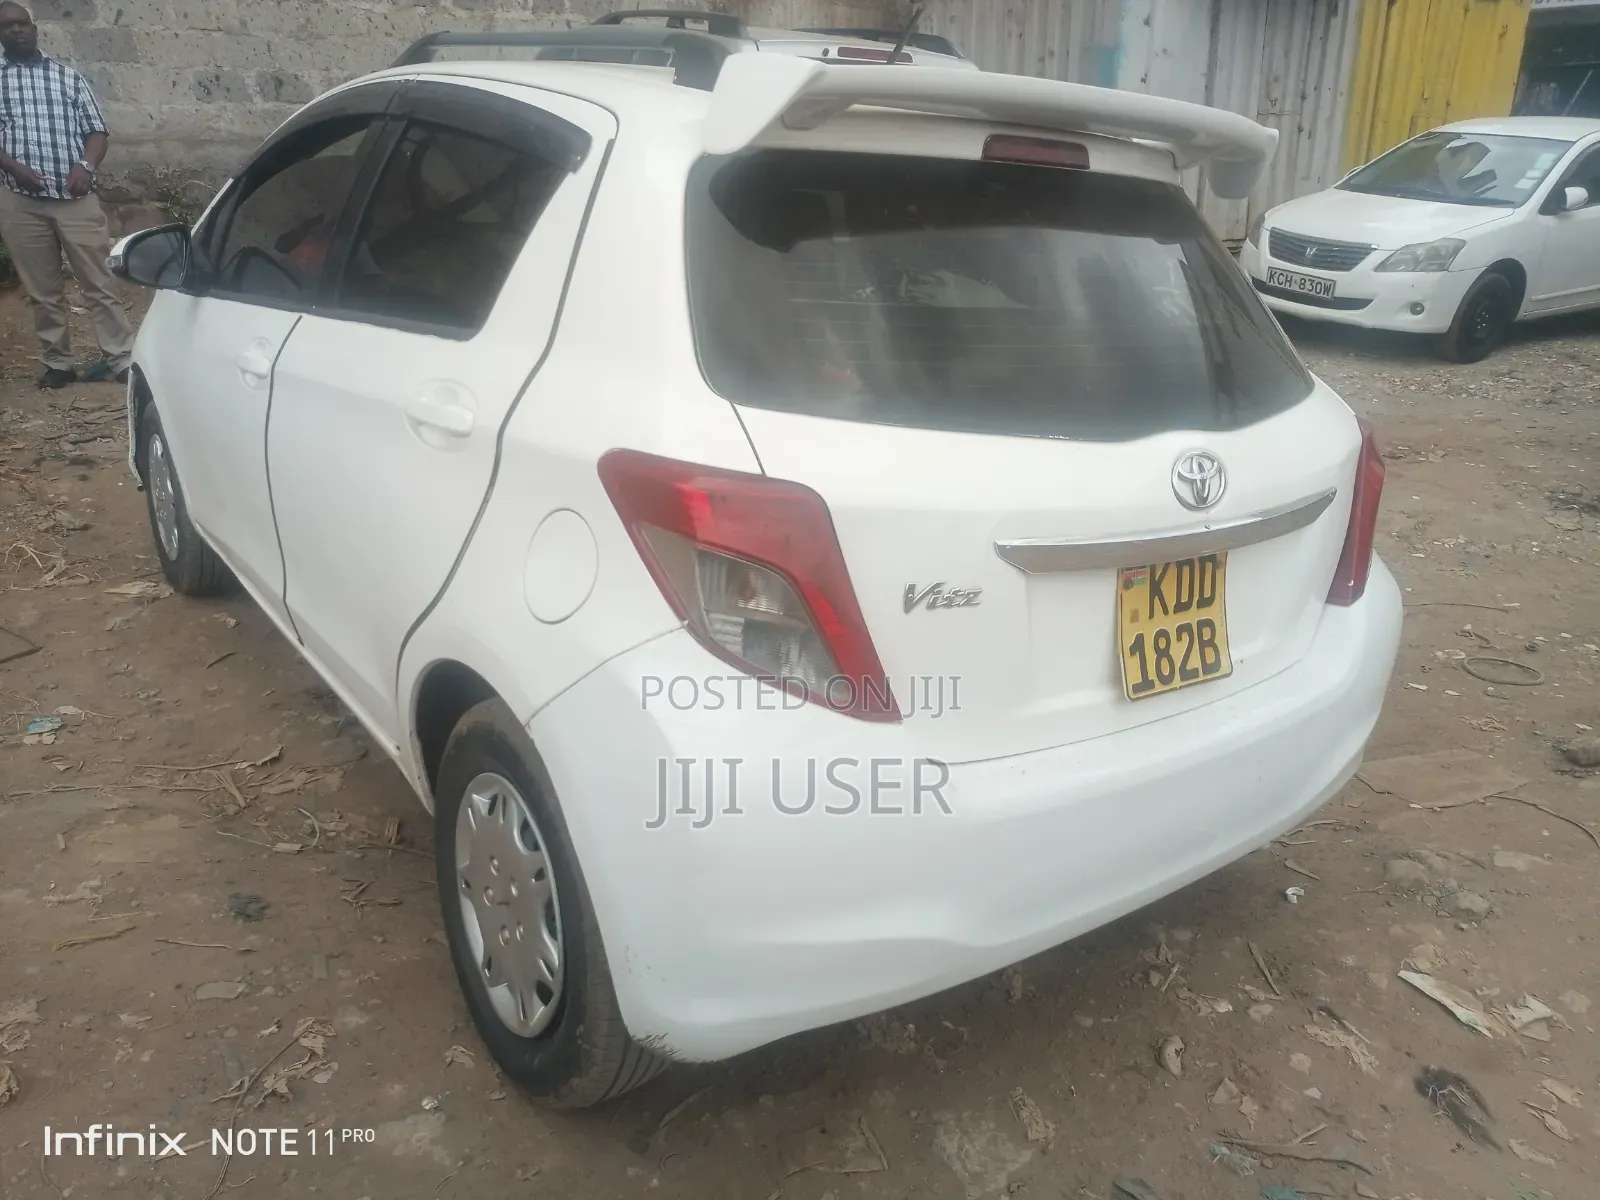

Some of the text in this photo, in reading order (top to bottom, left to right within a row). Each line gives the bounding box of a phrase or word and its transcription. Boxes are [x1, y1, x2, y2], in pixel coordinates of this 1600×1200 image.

[1268, 270, 1333, 297] KCH 830W
[1148, 553, 1218, 620] KDD
[1128, 617, 1222, 694] 182B
